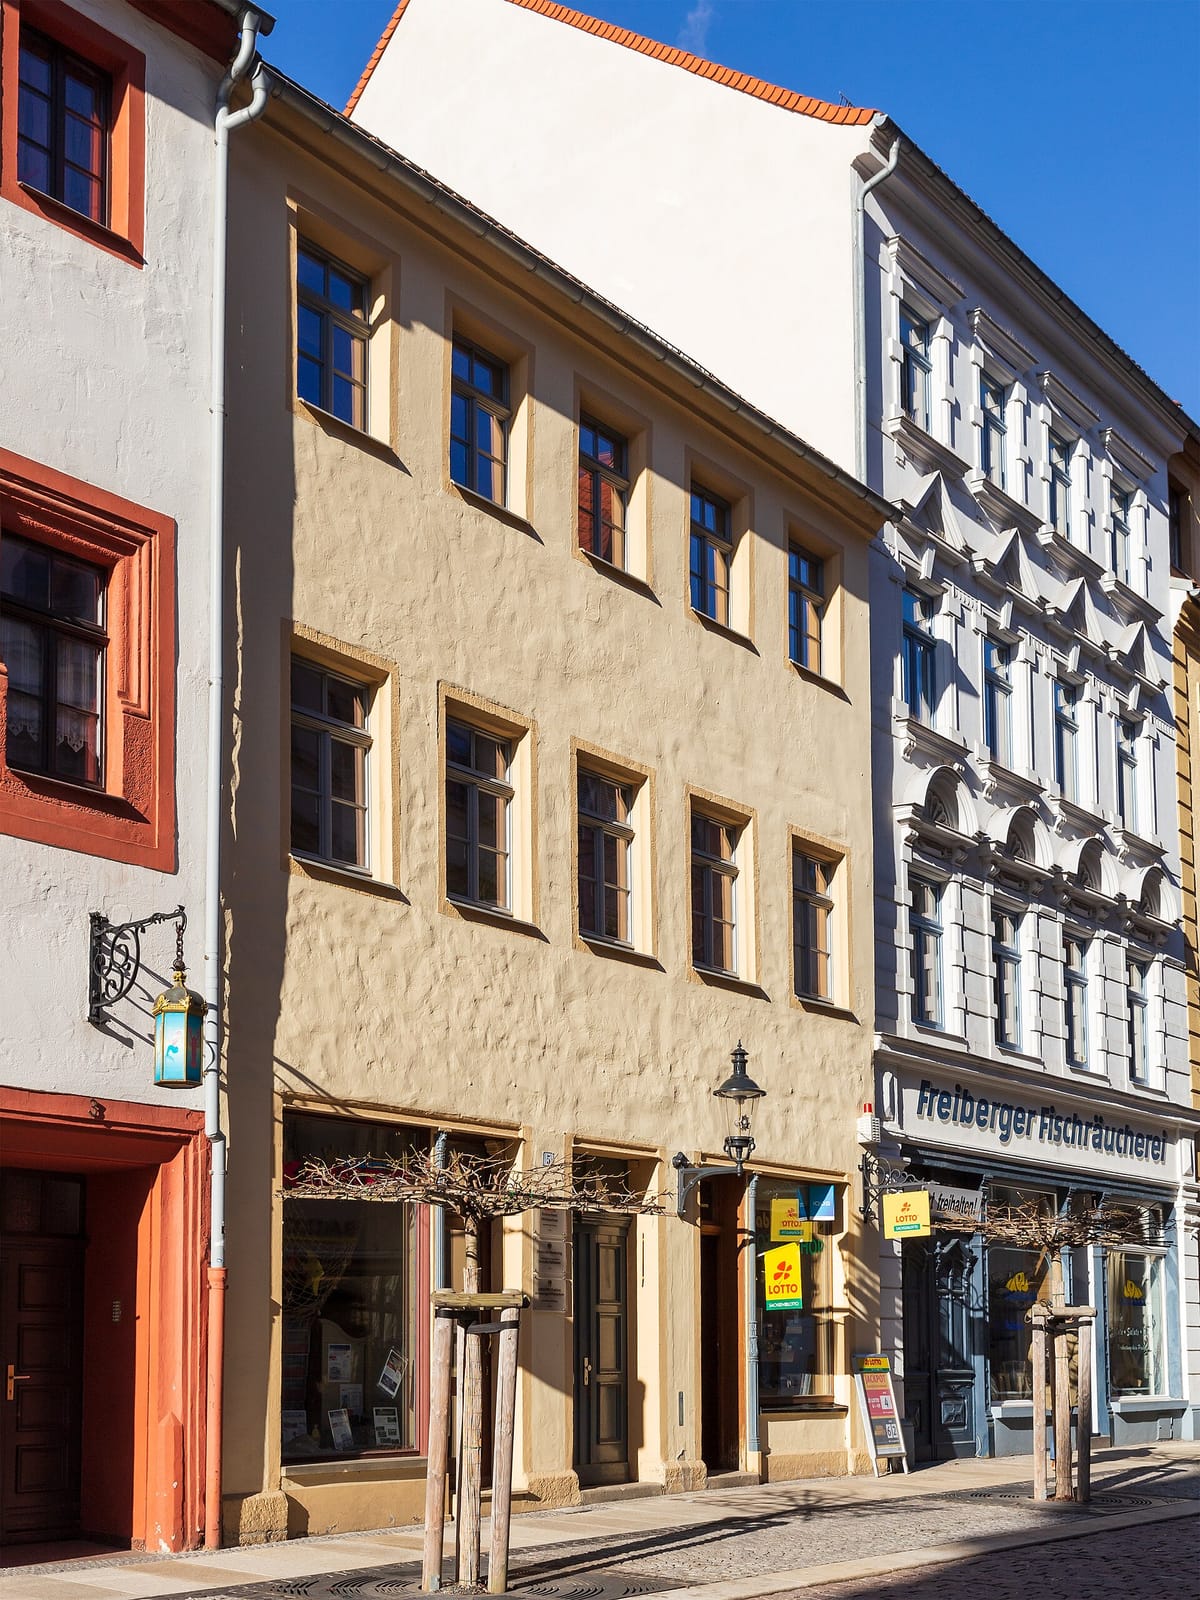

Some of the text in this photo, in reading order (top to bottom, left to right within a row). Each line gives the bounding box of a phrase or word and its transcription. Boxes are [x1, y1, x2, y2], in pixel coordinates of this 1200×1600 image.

[917, 1080, 1168, 1161] Freiberger Fischräucherei
[937, 1193, 978, 1215] freihalten!
[895, 1214, 918, 1223] LOTTO
[768, 1283, 798, 1294] LOTTO
[865, 1374, 886, 1384] JACKPOT
